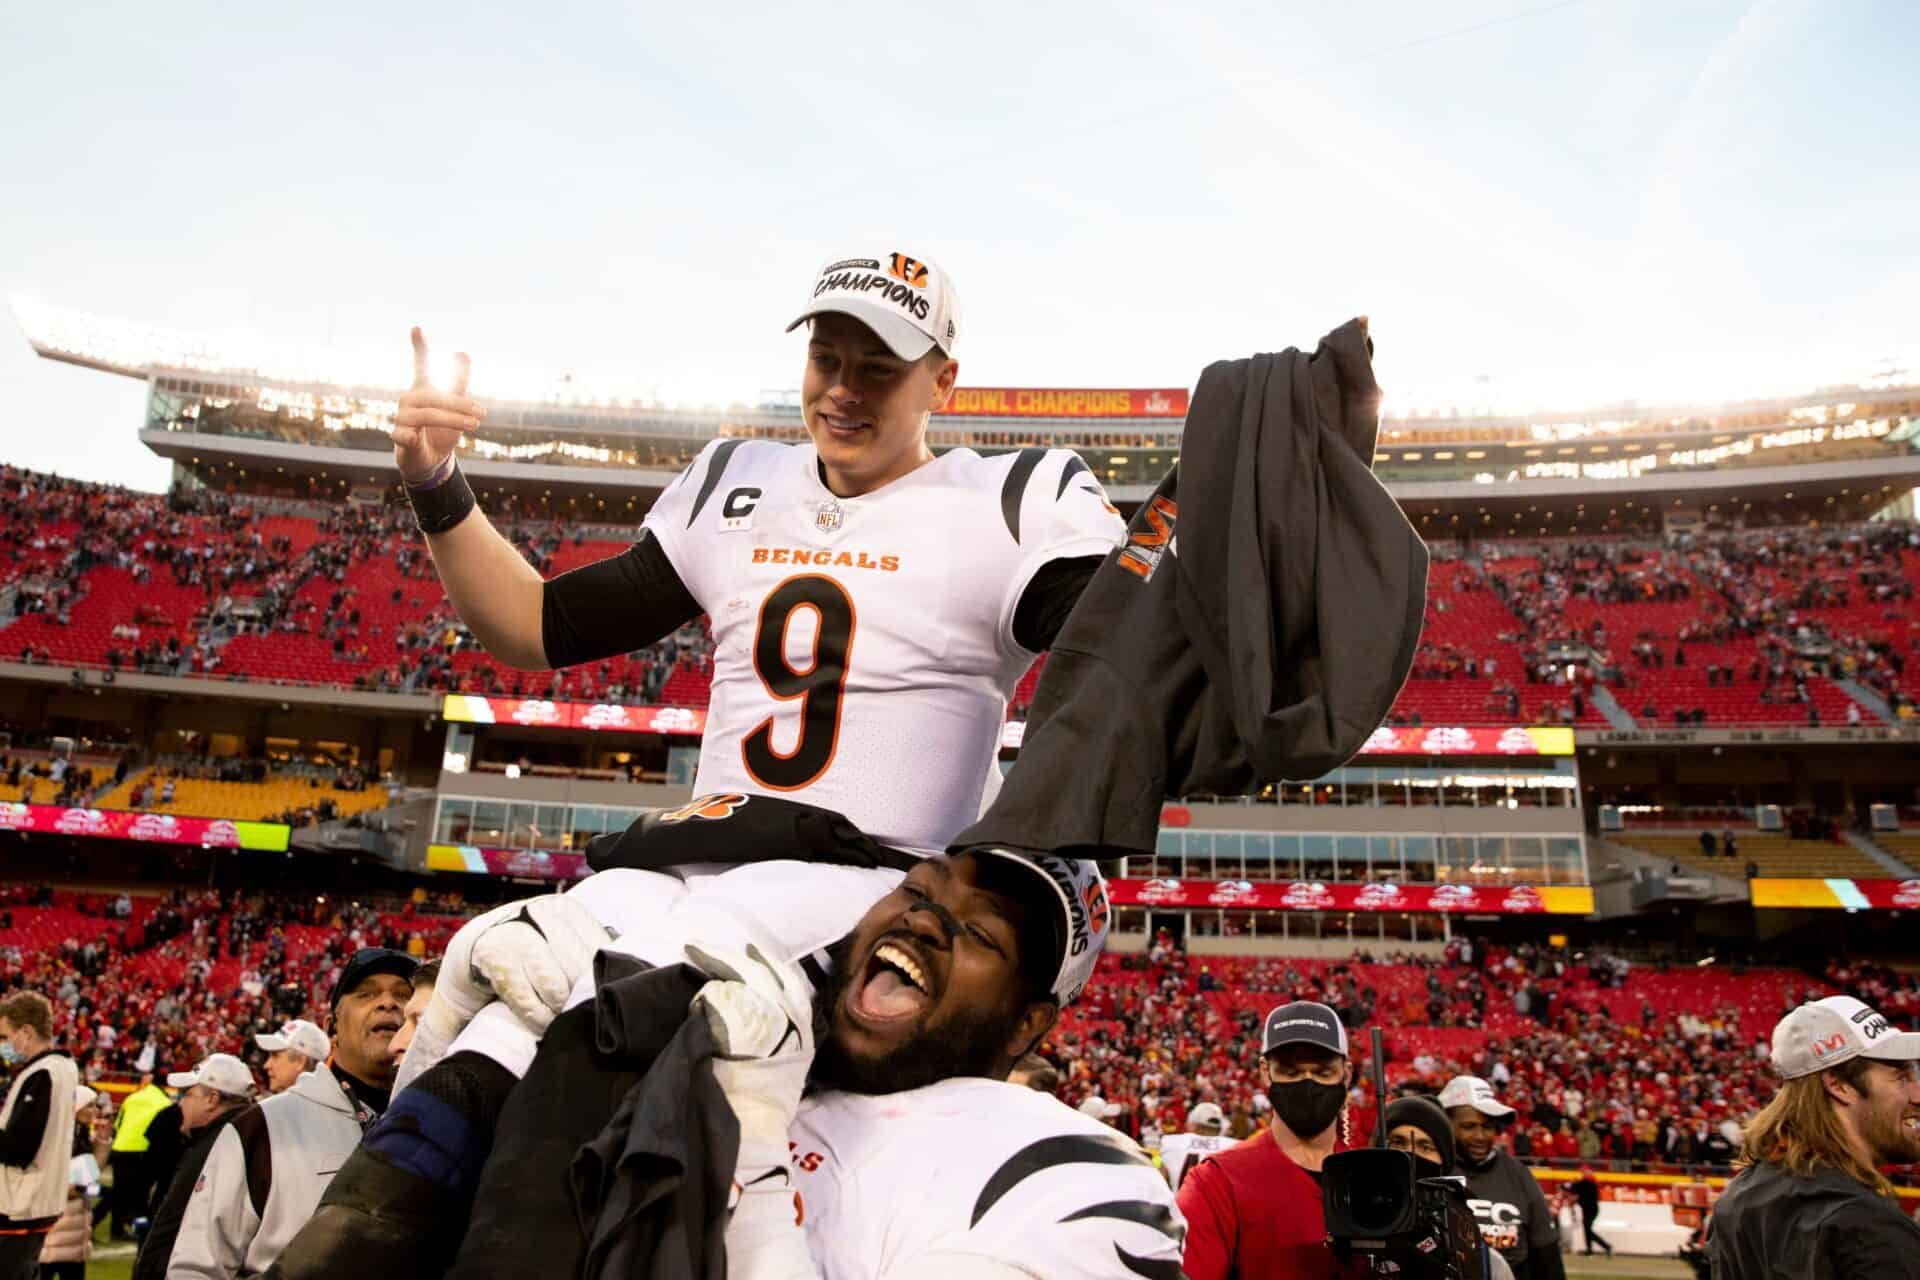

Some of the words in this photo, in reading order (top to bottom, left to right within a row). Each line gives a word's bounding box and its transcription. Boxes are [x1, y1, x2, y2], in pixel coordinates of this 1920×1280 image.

[813, 271, 931, 320] CHAMPIONS
[955, 391, 1010, 412] BOWL
[1016, 392, 1132, 414] CHAMPIONS
[723, 487, 762, 519] C
[817, 511, 841, 528] NFL
[752, 548, 900, 572] BENGALS
[740, 572, 857, 793] 9
